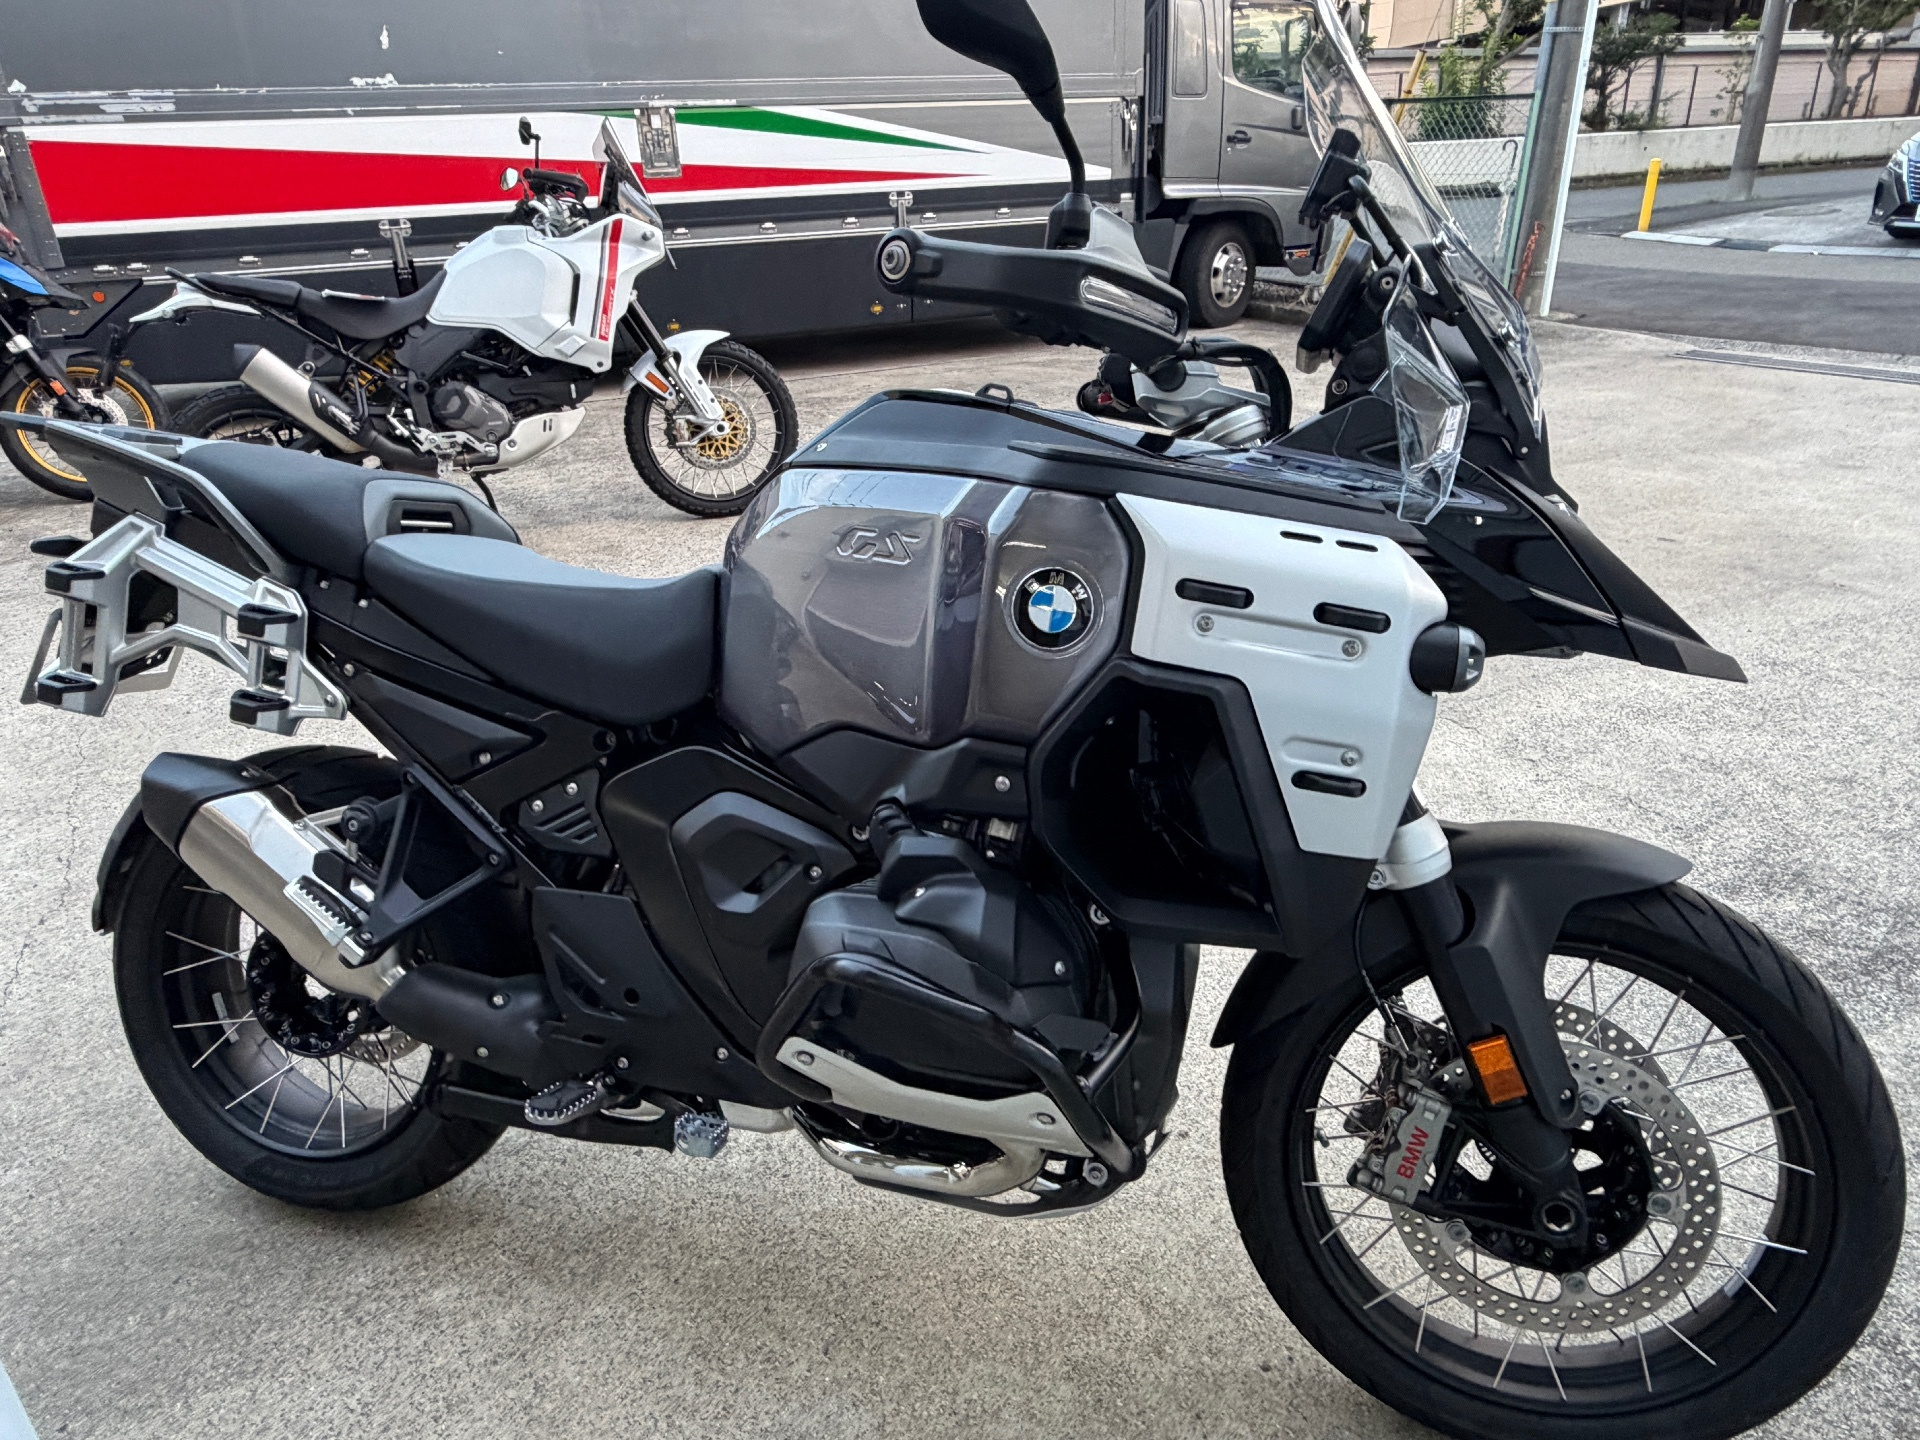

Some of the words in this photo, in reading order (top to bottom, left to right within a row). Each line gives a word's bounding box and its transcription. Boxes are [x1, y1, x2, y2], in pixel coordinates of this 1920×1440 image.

[836, 526, 921, 566] GS
[1024, 572, 1088, 601] BMW
[1397, 1125, 1430, 1180] BMW
